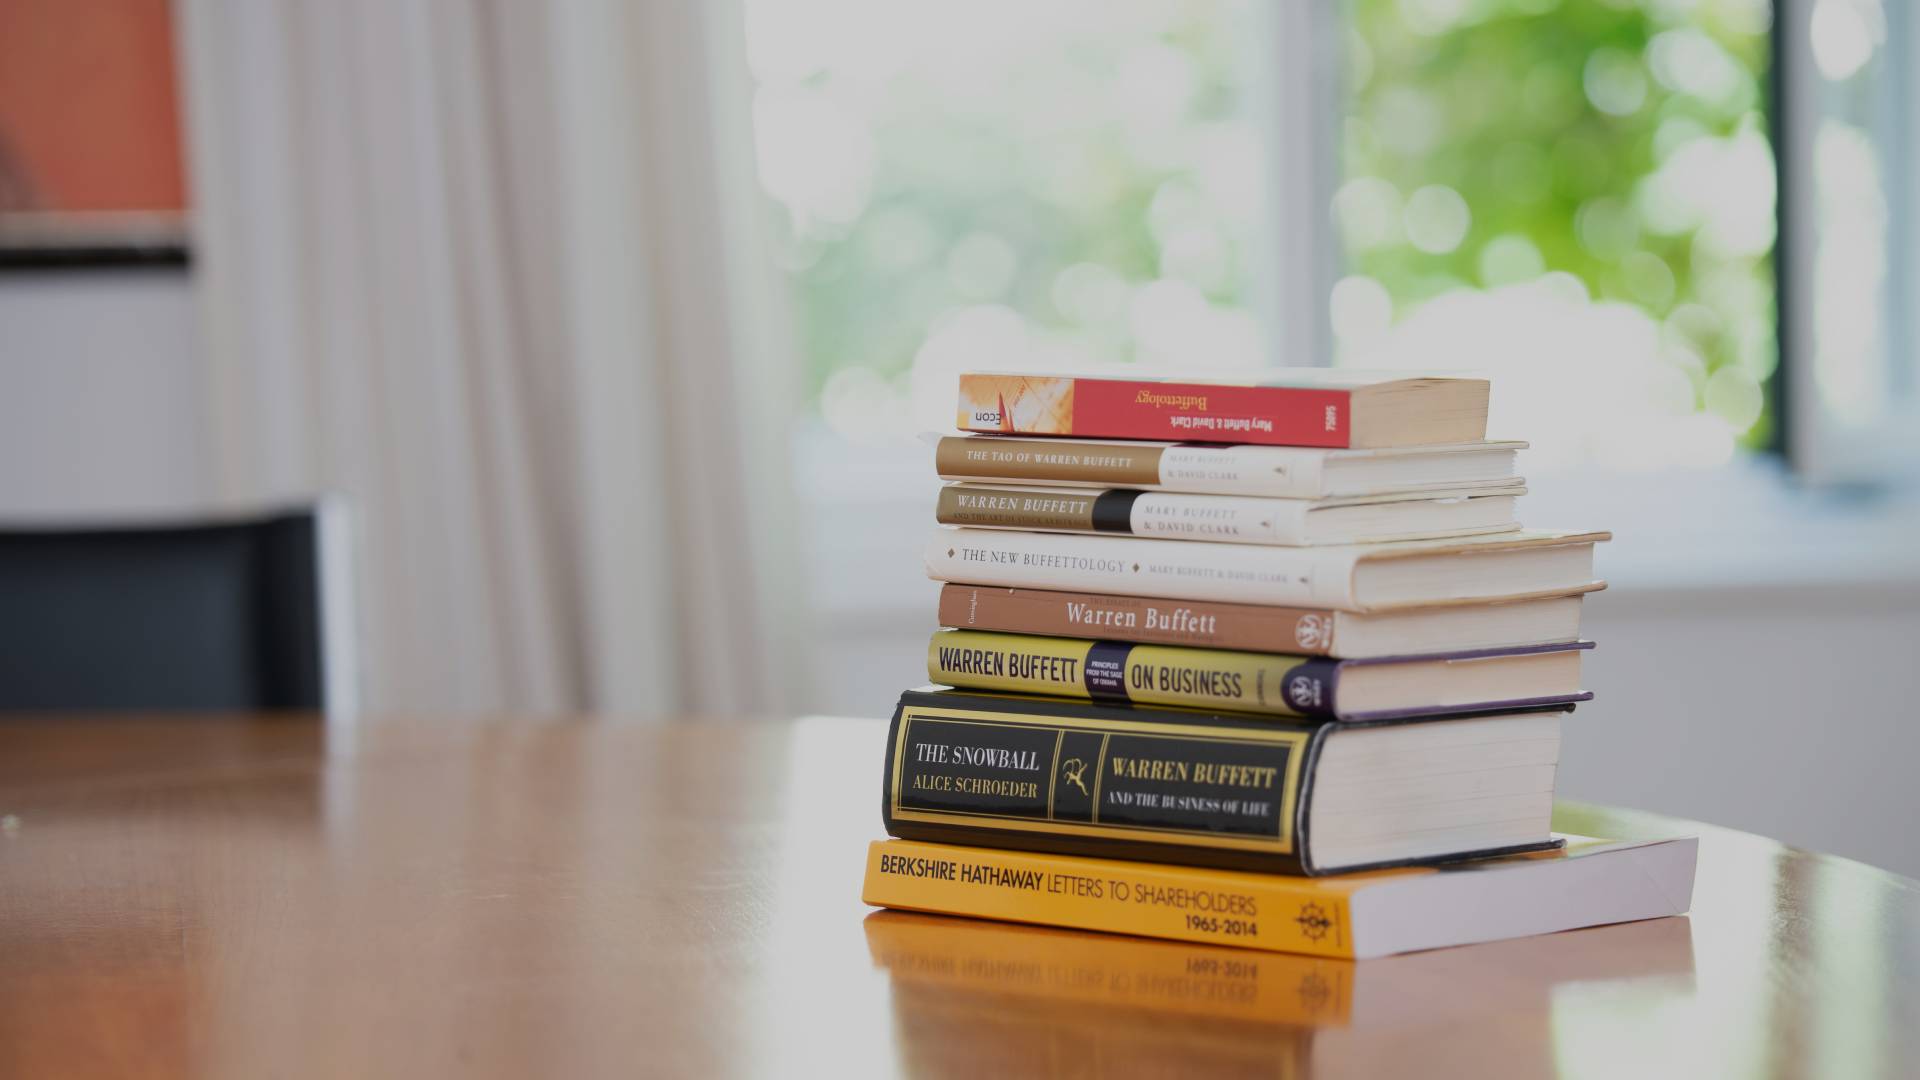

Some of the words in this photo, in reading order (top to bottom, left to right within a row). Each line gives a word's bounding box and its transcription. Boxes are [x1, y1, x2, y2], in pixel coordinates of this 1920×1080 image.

[1136, 391, 1207, 411] Buffettology
[1171, 415, 1192, 428] Clark
[1193, 416, 1215, 430] David
[1224, 417, 1250, 431] Buffett
[1251, 417, 1273, 432] Mary
[967, 450, 987, 461] THE
[992, 451, 1013, 462] TAO
[1016, 452, 1030, 463] OF
[1034, 454, 1080, 466] WARREN
[1083, 456, 1133, 468] BUFFETT
[958, 495, 1018, 510] WARREN
[1023, 498, 1088, 514] BUFFETT
[1183, 506, 1239, 519] BUFFETT
[1158, 523, 1195, 532] DAVID
[1200, 525, 1240, 535] CLARK
[962, 548, 986, 562] THE
[990, 550, 1020, 564] NEW
[1023, 553, 1125, 573] BUFFETTOLOGY
[1067, 602, 1136, 627] Warren
[1145, 608, 1216, 634] Buffett
[939, 646, 1004, 676] WARREN
[1009, 652, 1078, 683] BUFFETT
[1131, 664, 1154, 690] ON
[1159, 666, 1242, 698] BUSINESS
[916, 743, 949, 764] THE
[952, 746, 1040, 771] SNOWBALL
[1112, 757, 1189, 782] WARREN
[1193, 763, 1278, 789] BUFFETT
[912, 774, 952, 791] ALICE
[954, 776, 1038, 798] SCHROEDER
[1107, 791, 1133, 805] AND
[1135, 793, 1159, 808] THE
[1161, 795, 1221, 813] BUSINESS
[1222, 800, 1239, 814] OF
[1241, 801, 1272, 817] LIFE
[880, 854, 957, 881] BERKSHIRE
[960, 863, 1044, 891] HATHAWAY
[1047, 873, 1104, 899] LETTERS
[1109, 880, 1130, 900] TO
[1134, 883, 1257, 917] SHAREHOLDERS
[1185, 914, 1258, 937] 1965-2014
